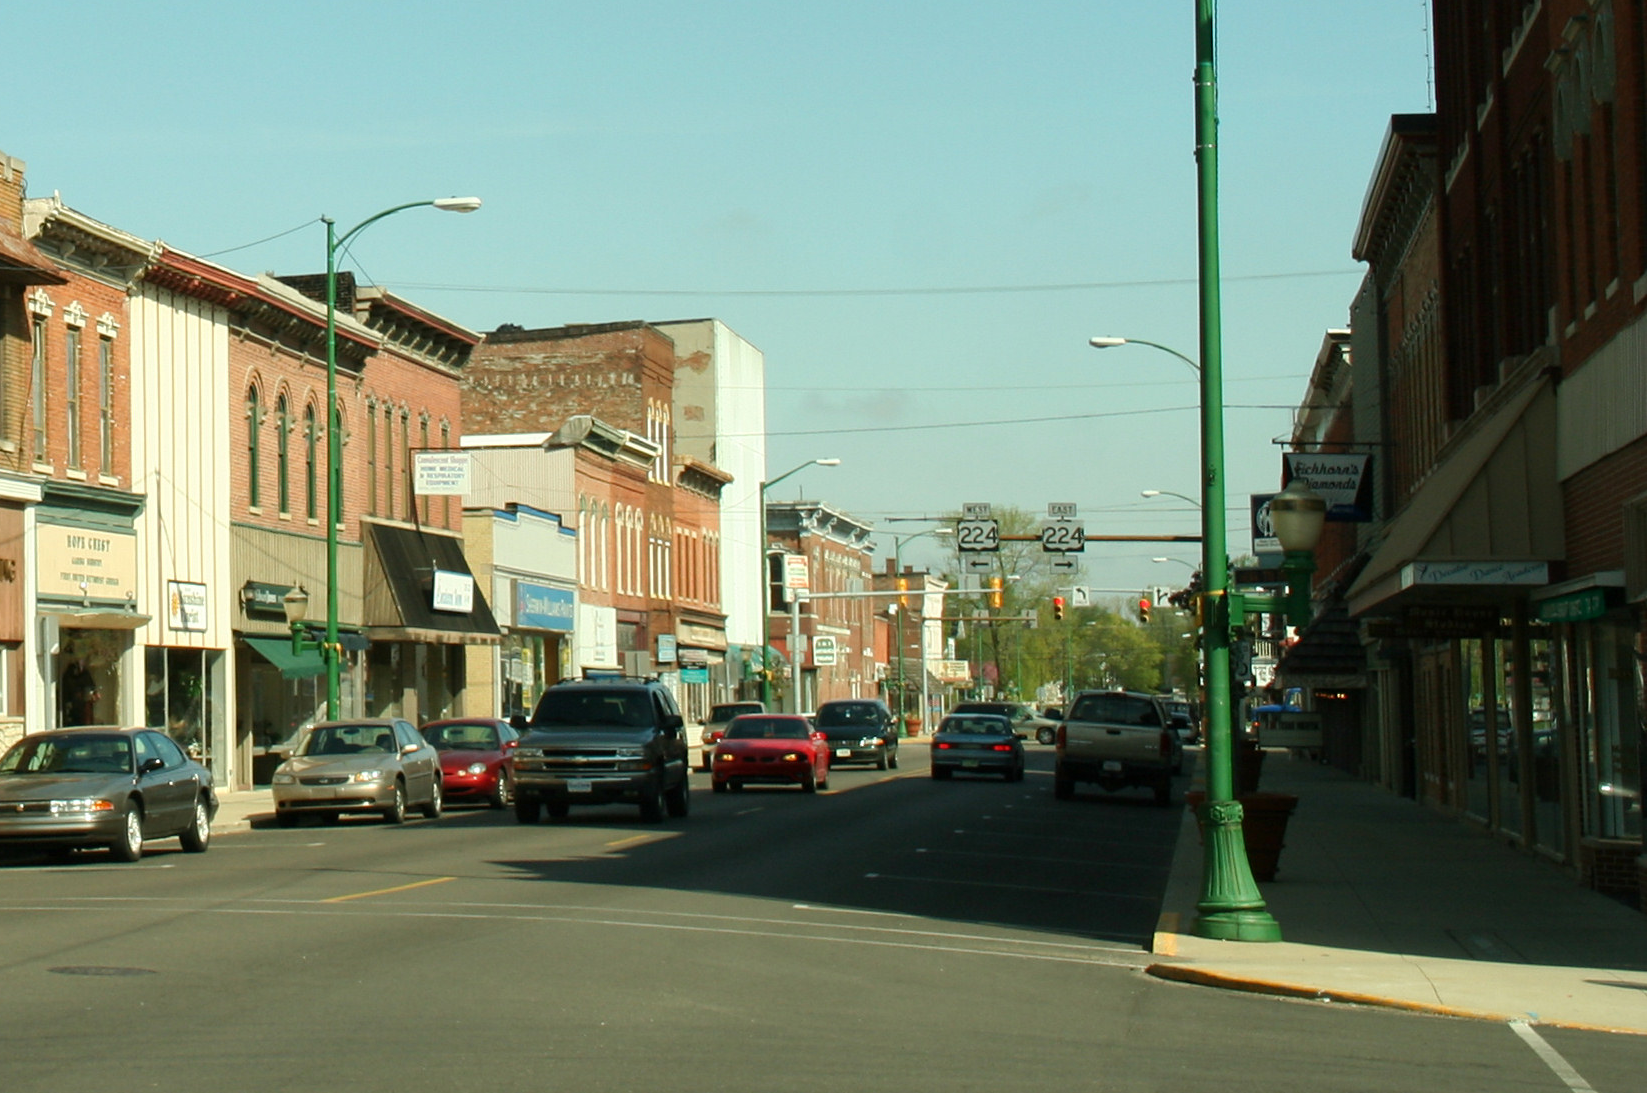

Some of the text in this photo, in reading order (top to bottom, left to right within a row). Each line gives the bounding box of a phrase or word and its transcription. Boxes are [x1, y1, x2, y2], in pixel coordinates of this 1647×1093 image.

[966, 505, 988, 514] WEST
[1051, 505, 1073, 515] EAST
[960, 526, 997, 544] 224
[1045, 526, 1083, 545] 224
